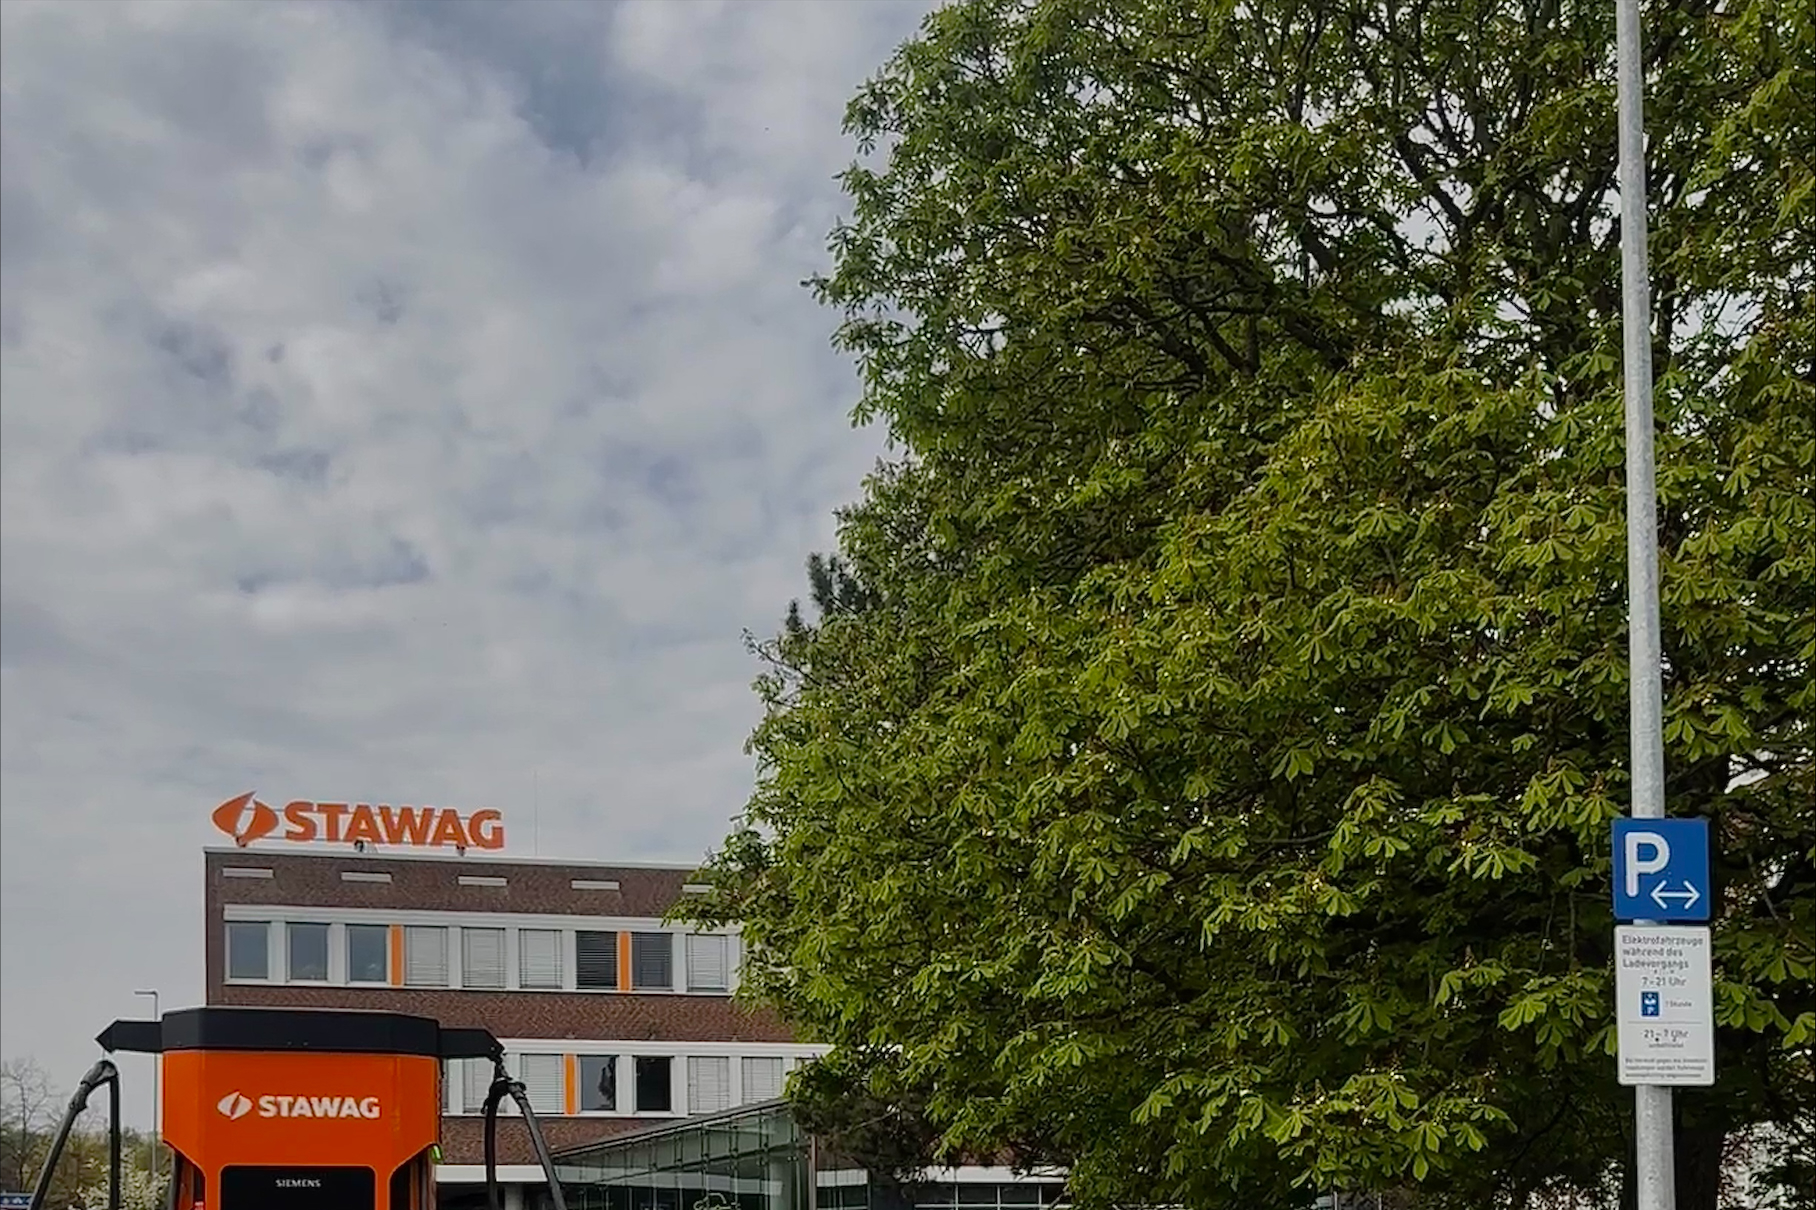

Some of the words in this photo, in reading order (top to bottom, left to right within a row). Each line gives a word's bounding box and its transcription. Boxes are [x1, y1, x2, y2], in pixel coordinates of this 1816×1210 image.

[284, 801, 504, 849] STAWAG
[1625, 831, 1670, 898] P
[1622, 934, 1704, 947] Elektrofahrzeuge
[1623, 947, 1664, 957] während
[1666, 947, 1683, 957] des
[1623, 959, 1689, 969] Ladevorgangs
[1668, 976, 1687, 986] Uhr
[259, 1095, 381, 1118] STAWAG
[275, 1179, 322, 1188] SIEMENS
